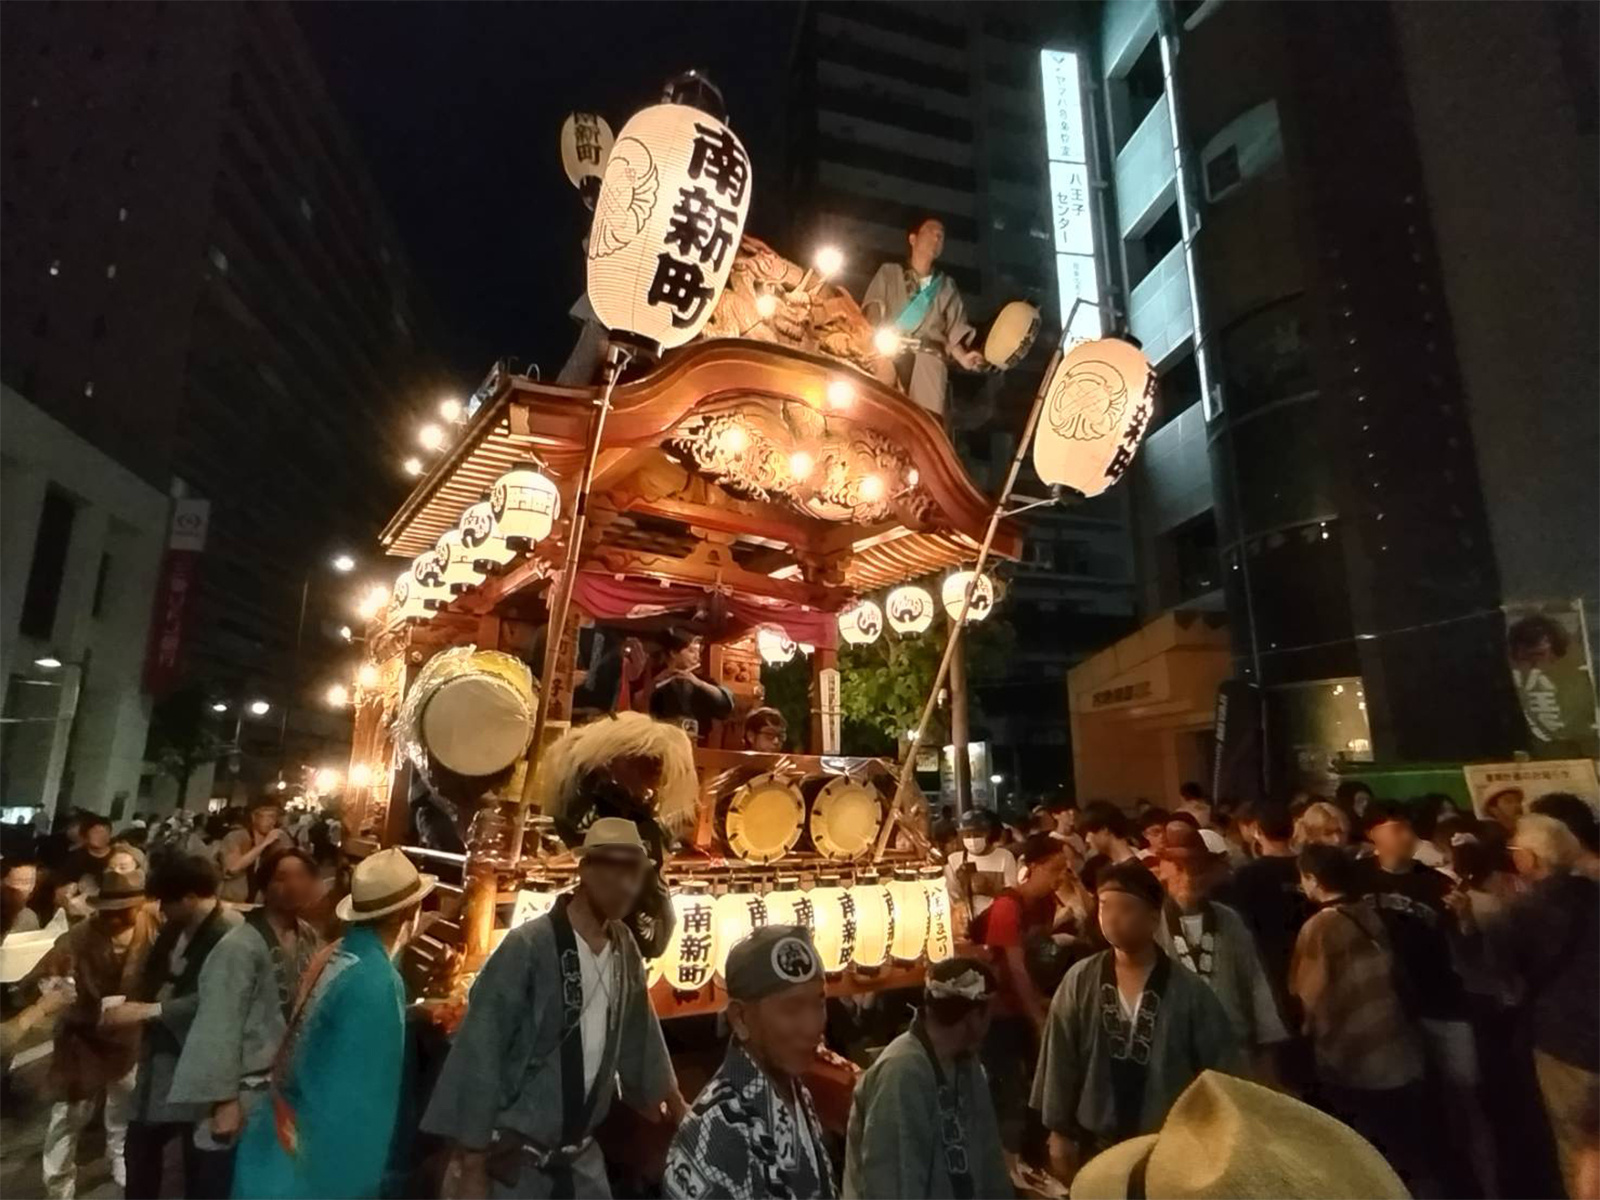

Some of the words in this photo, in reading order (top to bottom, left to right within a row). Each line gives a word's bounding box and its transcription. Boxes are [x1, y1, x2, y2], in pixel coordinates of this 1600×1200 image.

[647, 122, 749, 329] 南新町
[1057, 191, 1070, 243] センター
[1070, 172, 1085, 217] 八王子
[677, 902, 713, 985] 南新町
[837, 891, 857, 965] 南新町
